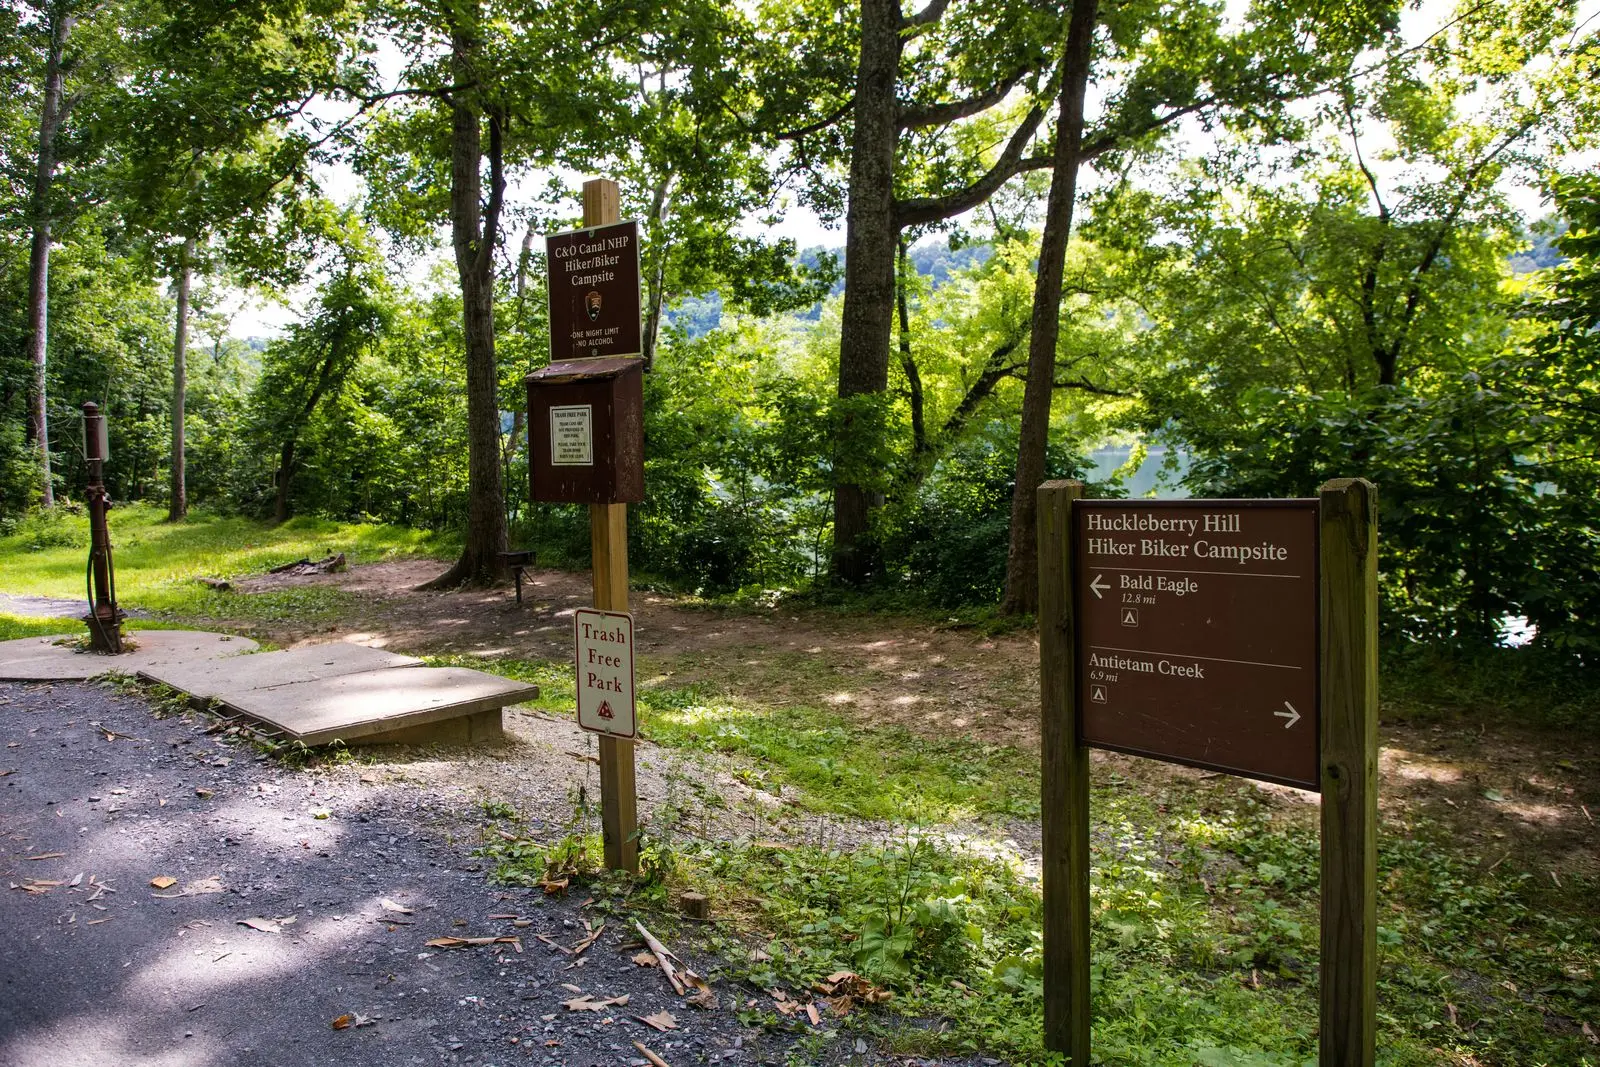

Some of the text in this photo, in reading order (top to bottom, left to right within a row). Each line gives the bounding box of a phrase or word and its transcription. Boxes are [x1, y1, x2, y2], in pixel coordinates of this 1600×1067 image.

[555, 236, 629, 258] C&O Canal NHP
[565, 254, 619, 272] Hiker/Biker
[571, 270, 614, 286] Campsite
[586, 329, 602, 337] NIGHT
[604, 327, 619, 335] LIMIT
[588, 337, 613, 346] ALCOHOL
[1087, 514, 1241, 536] Huckleberry Hill
[1087, 538, 1288, 564] Hiker Biker Campsite
[1120, 574, 1198, 596] Bald Eagle
[1121, 593, 1156, 605] 12.8 mi
[582, 623, 625, 644] Trash
[588, 648, 620, 667] Free
[1089, 653, 1204, 679] Antietam Creek
[587, 672, 623, 692] Park
[1090, 671, 1119, 682] 6.9 mi
